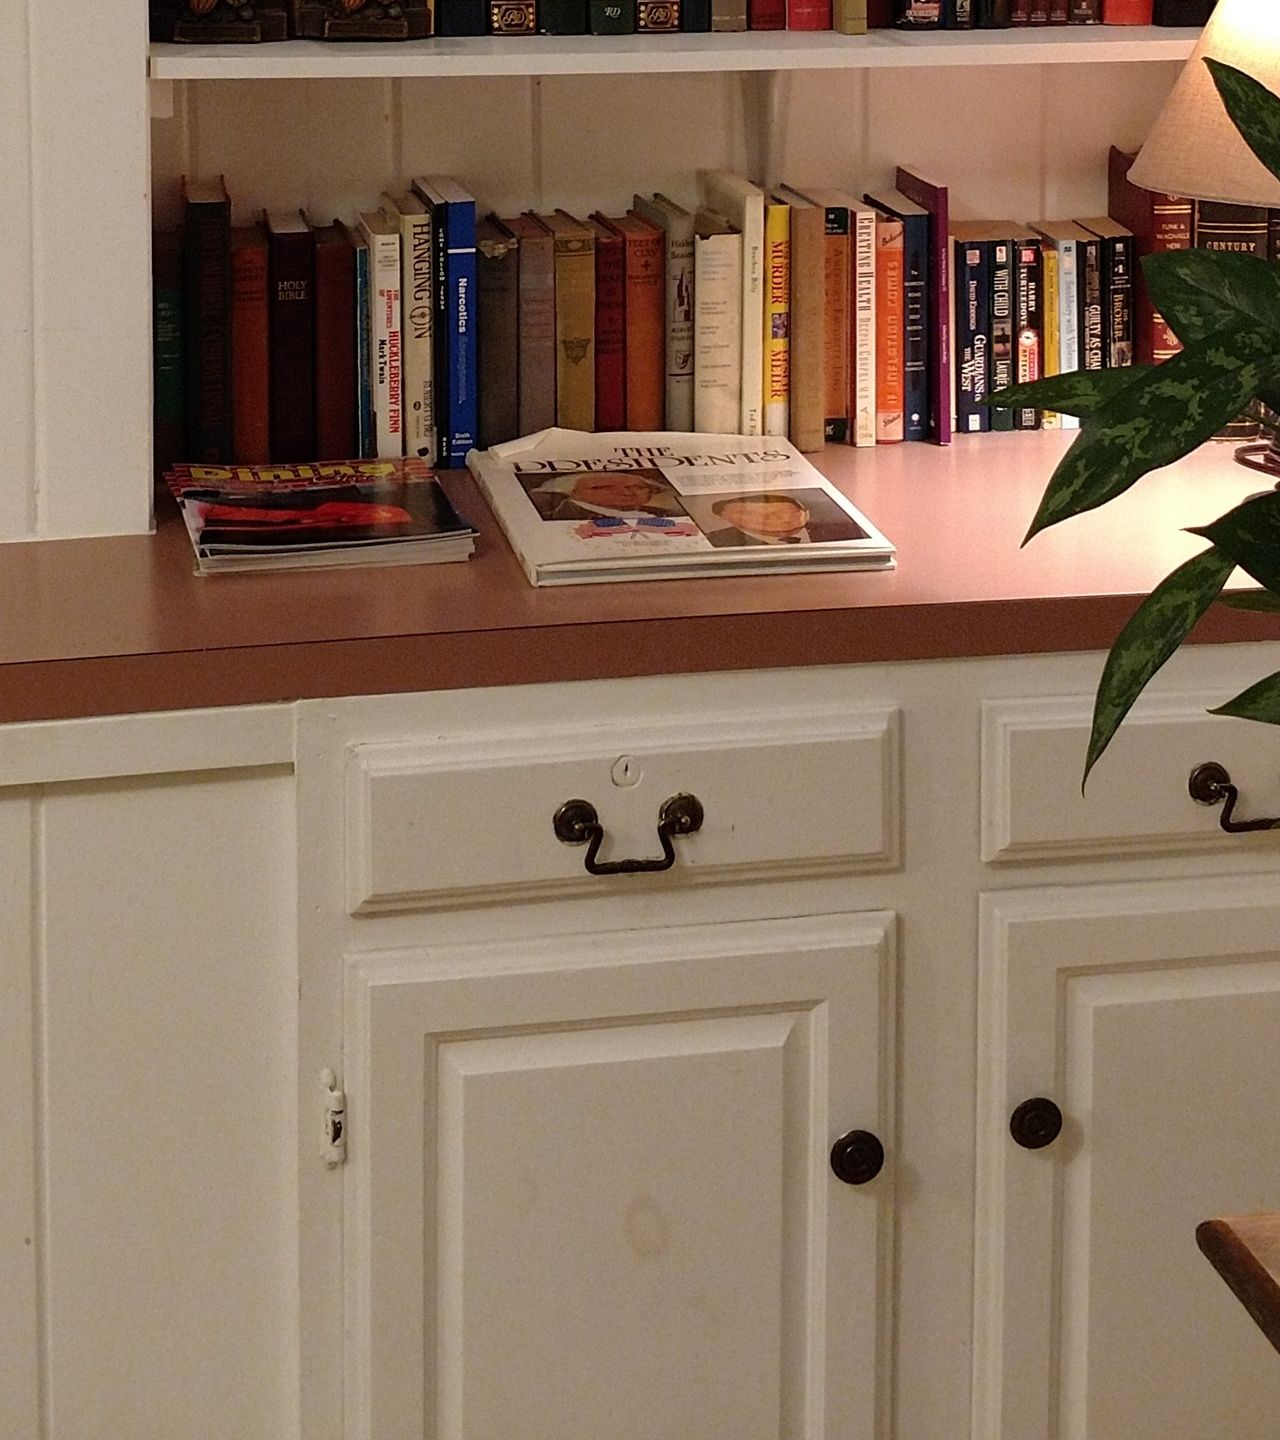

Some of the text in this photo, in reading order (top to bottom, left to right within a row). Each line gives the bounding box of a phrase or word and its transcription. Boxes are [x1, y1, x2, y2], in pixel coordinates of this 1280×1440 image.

[604, 7, 621, 17] RD
[858, 217, 874, 311] CREATING HEALTH
[1205, 241, 1256, 252] CENTURY
[277, 280, 308, 291] HOLY
[409, 222, 433, 340] HANGING ON
[771, 241, 783, 305] MURDER
[277, 290, 308, 301] BIBLE
[458, 277, 468, 333] Narcotics
[993, 269, 1009, 317] WITH CHILD
[1028, 282, 1036, 313] HARRY
[1089, 304, 1102, 348] GUILTY AS
[1113, 292, 1124, 337] BROKER
[378, 339, 388, 384] Mark Twain
[961, 360, 974, 392] WEST
[974, 334, 987, 393] GUARDIANS
[993, 360, 1010, 385] LAURIE
[389, 330, 400, 434] HUCKLEBERRY FINN
[514, 449, 791, 473] PRESIDENTS
[613, 446, 674, 458] THE
[189, 463, 397, 481] Dining
